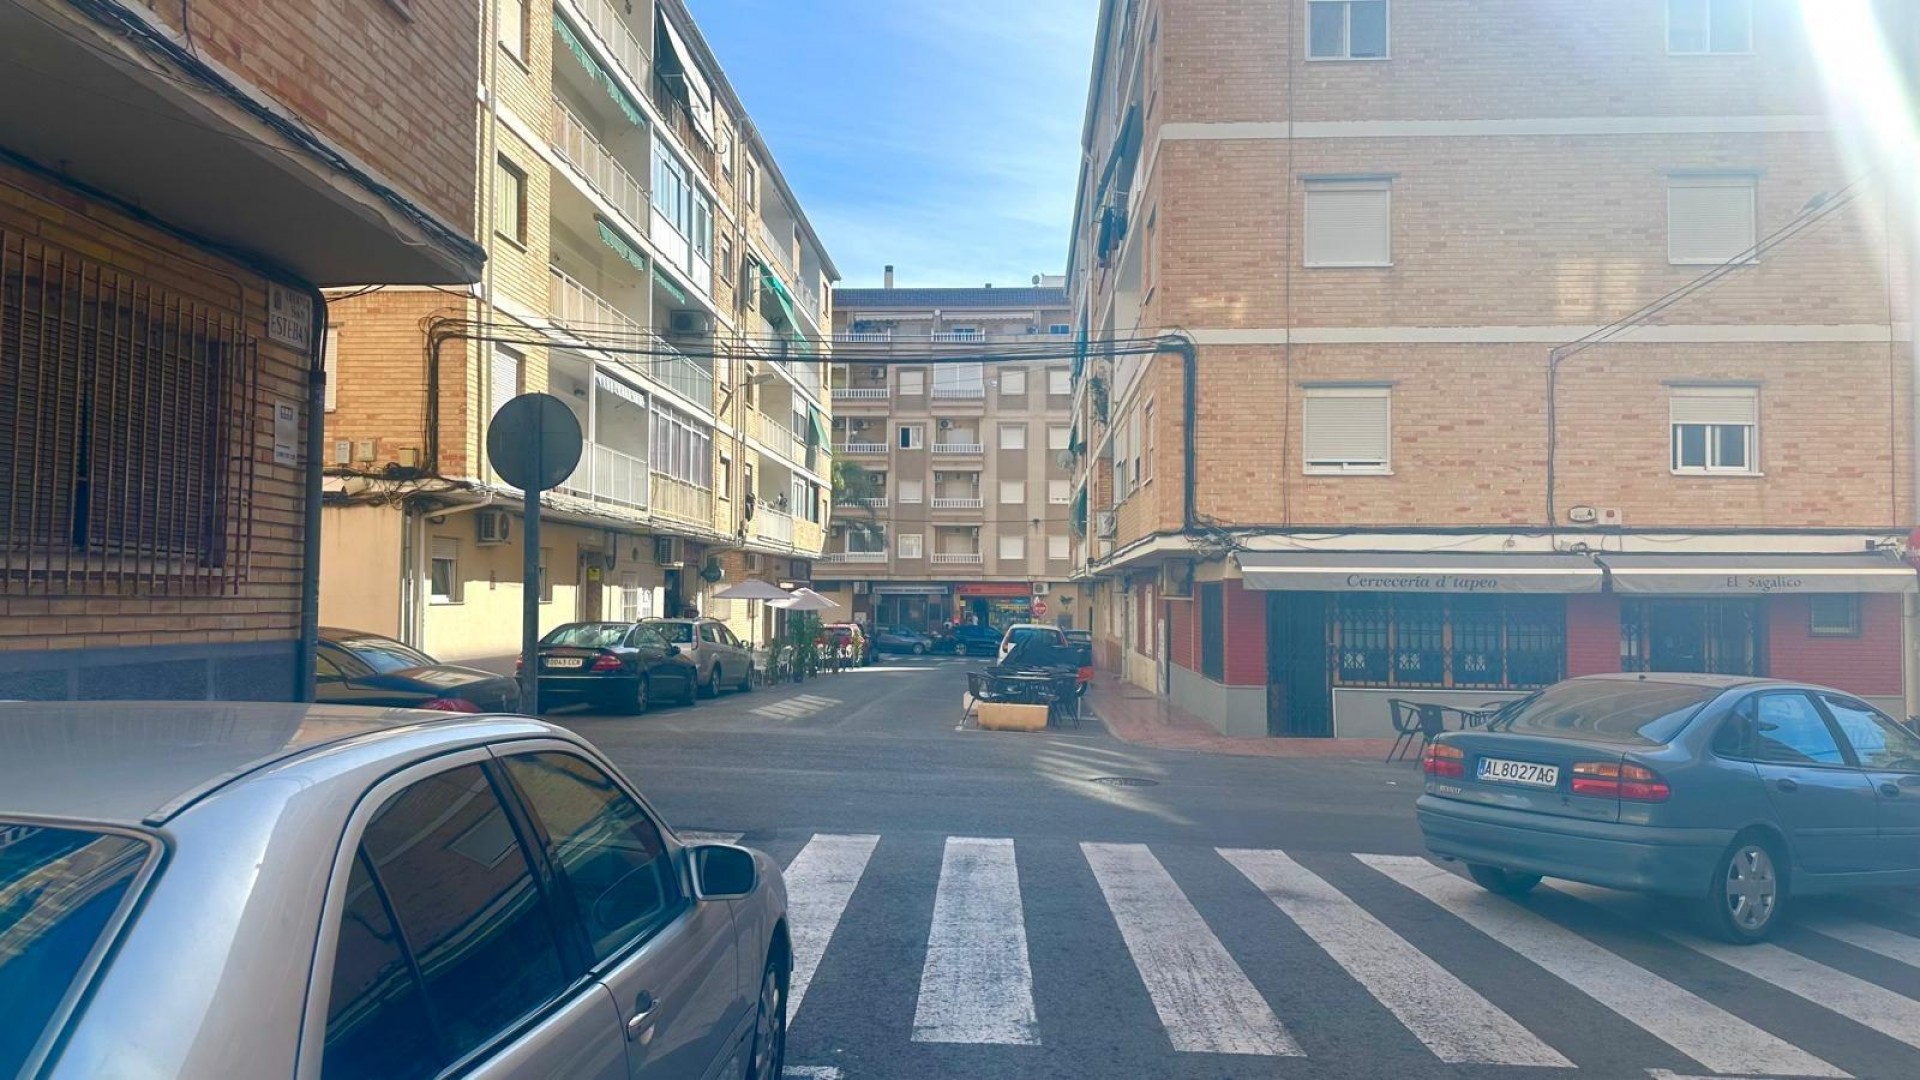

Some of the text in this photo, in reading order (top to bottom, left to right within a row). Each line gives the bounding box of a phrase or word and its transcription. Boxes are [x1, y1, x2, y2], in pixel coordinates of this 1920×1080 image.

[1346, 574, 1430, 588] Cervecería
[1726, 575, 1802, 592] El Sagalico
[1486, 761, 1555, 783] AL8027AG
